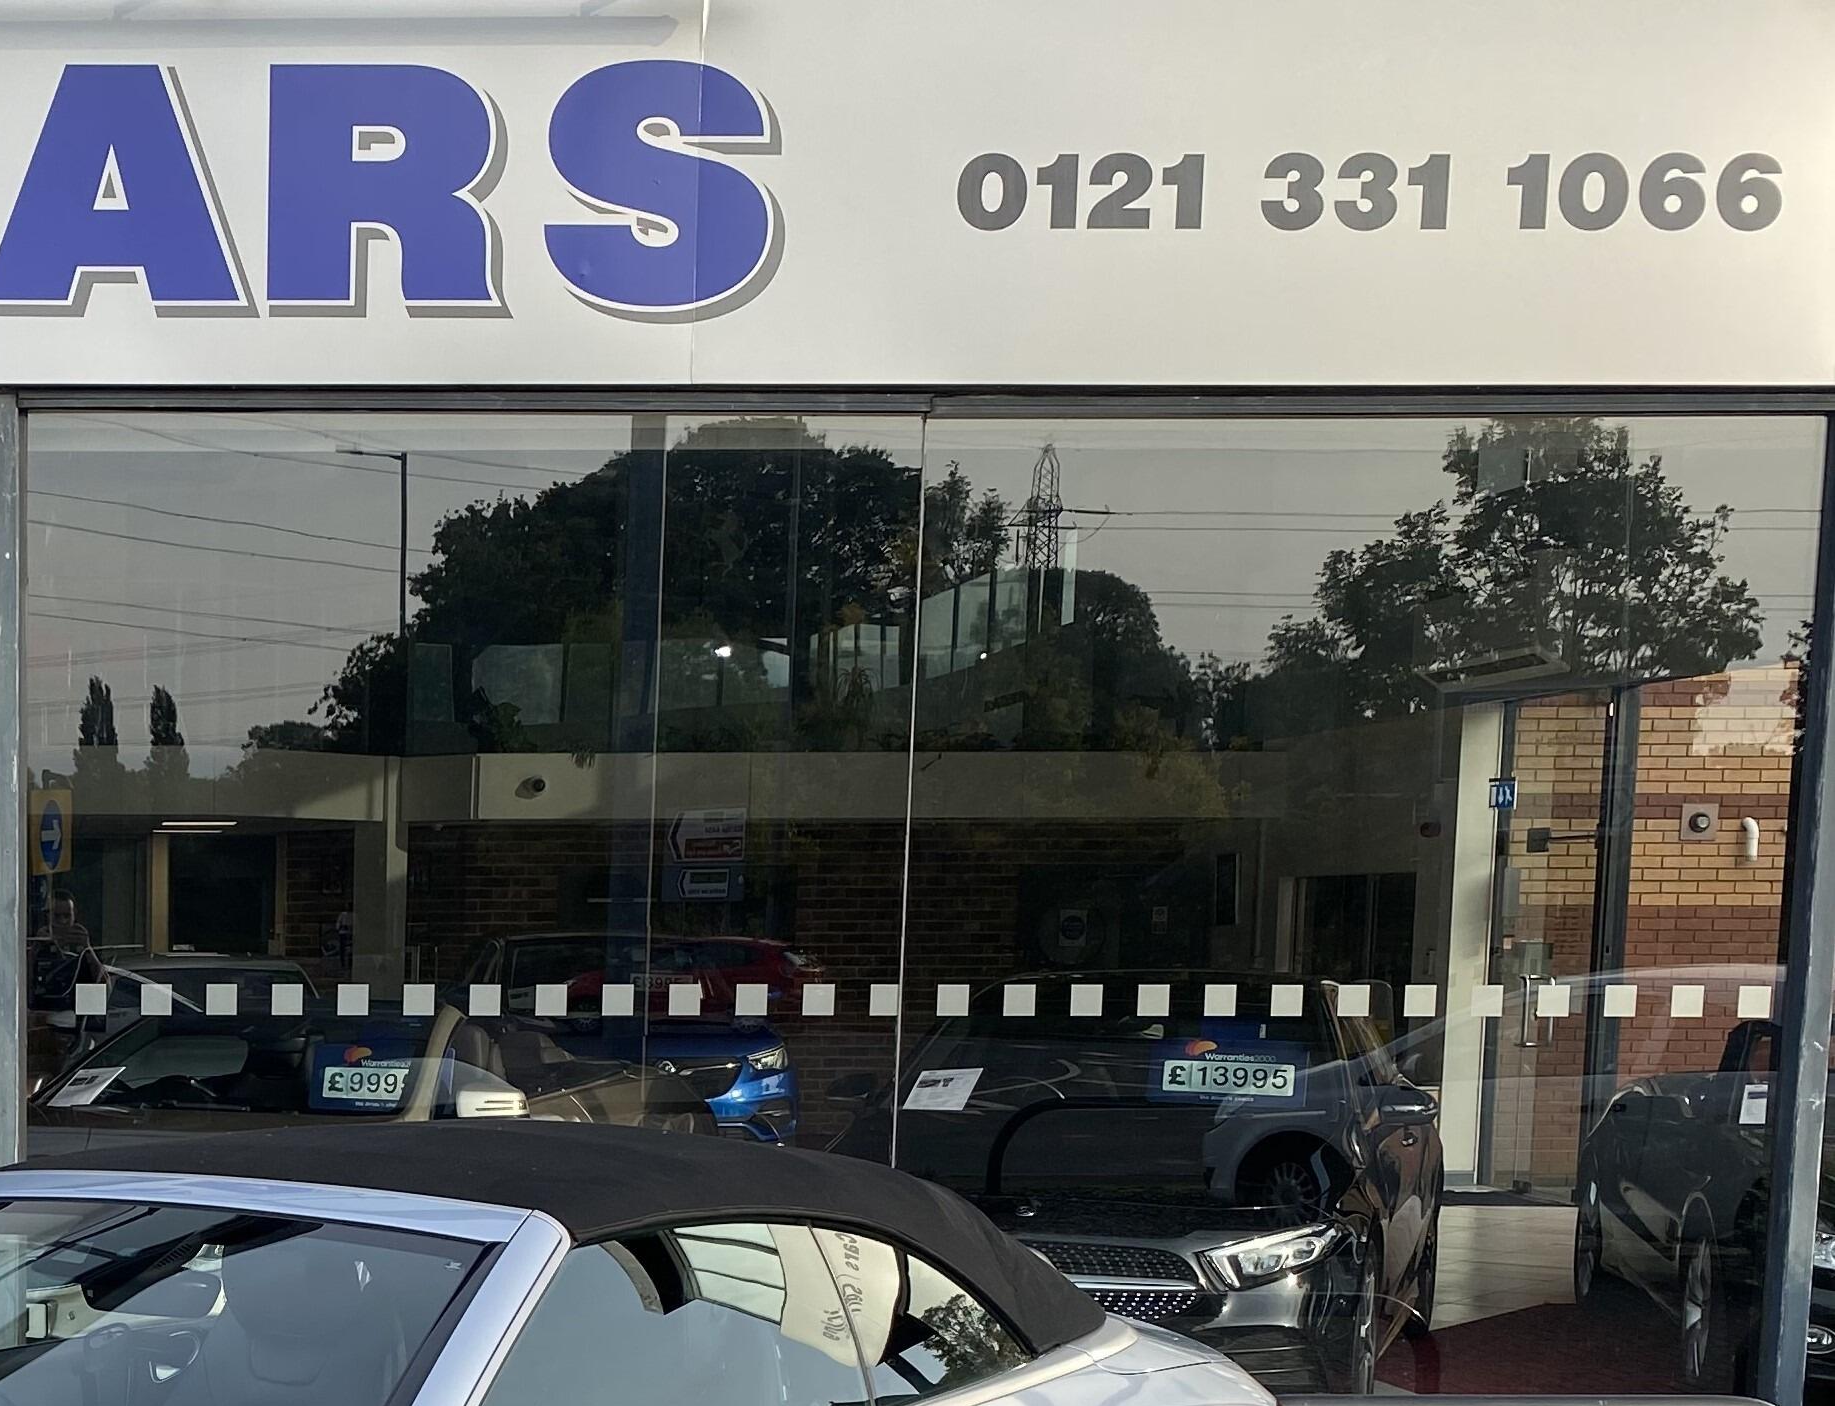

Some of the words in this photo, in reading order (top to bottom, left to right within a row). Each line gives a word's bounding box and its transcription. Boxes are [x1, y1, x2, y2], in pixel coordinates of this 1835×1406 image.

[956, 152, 1205, 231] 0121
[1261, 152, 1451, 231] 331
[1507, 152, 1784, 231] 1066
[1168, 1065, 1288, 1090] £13995
